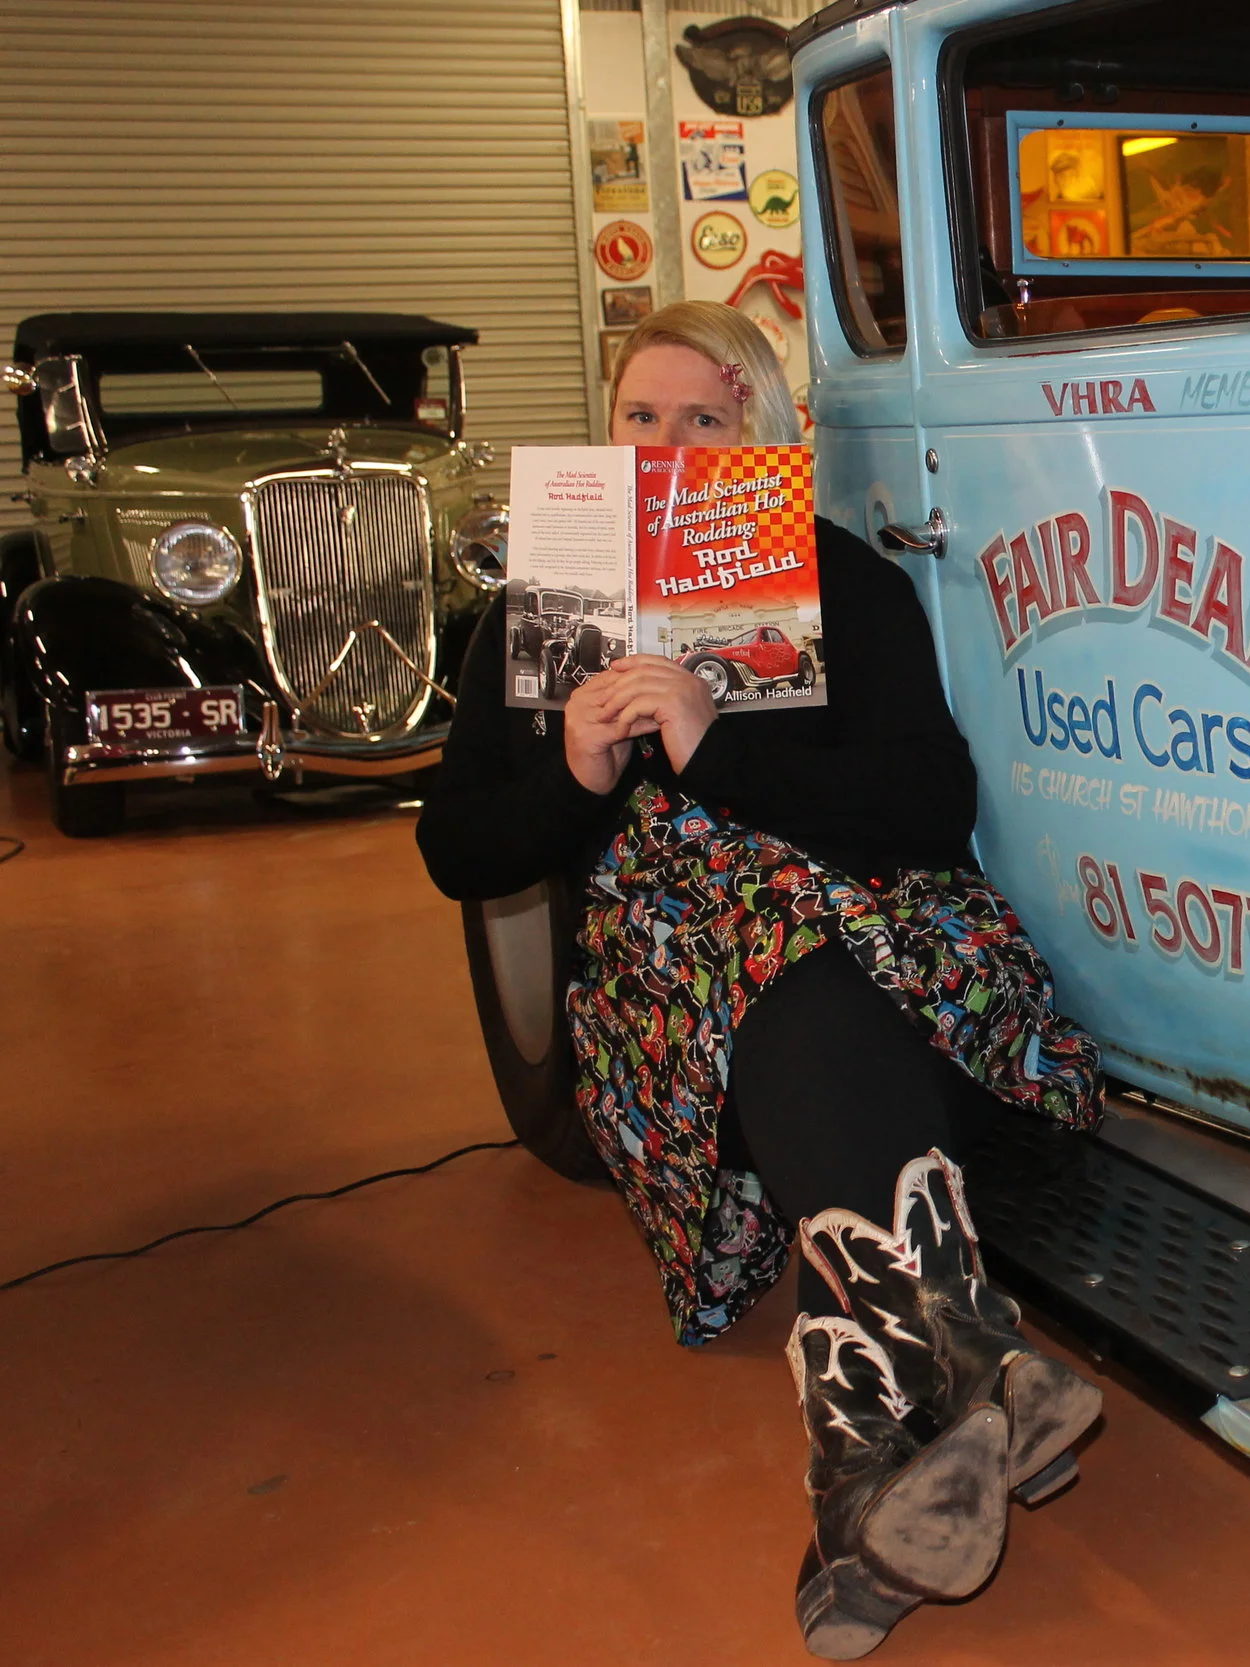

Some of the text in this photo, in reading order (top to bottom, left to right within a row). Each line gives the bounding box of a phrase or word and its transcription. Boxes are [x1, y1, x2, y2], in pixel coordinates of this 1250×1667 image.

[1041, 378, 1157, 417] VHRA
[651, 460, 685, 468] RENNIKS
[548, 492, 604, 502] Rod Hadfield
[644, 473, 783, 512] The Mad Scientist
[647, 493, 786, 537] of Australian Hot
[682, 521, 756, 547] Rodding:
[655, 551, 804, 597] Hadfield
[693, 541, 758, 568] Rod
[975, 511, 1102, 662] FAIR
[724, 686, 812, 702] Allison Hadfield
[100, 699, 238, 731] 1535 SR
[146, 729, 192, 739] VICTORIA
[1015, 666, 1124, 763] Used
[1010, 761, 1034, 797] 115
[1038, 768, 1113, 812] CHURCH
[1119, 783, 1150, 820] ST
[1076, 853, 1138, 946] 81
